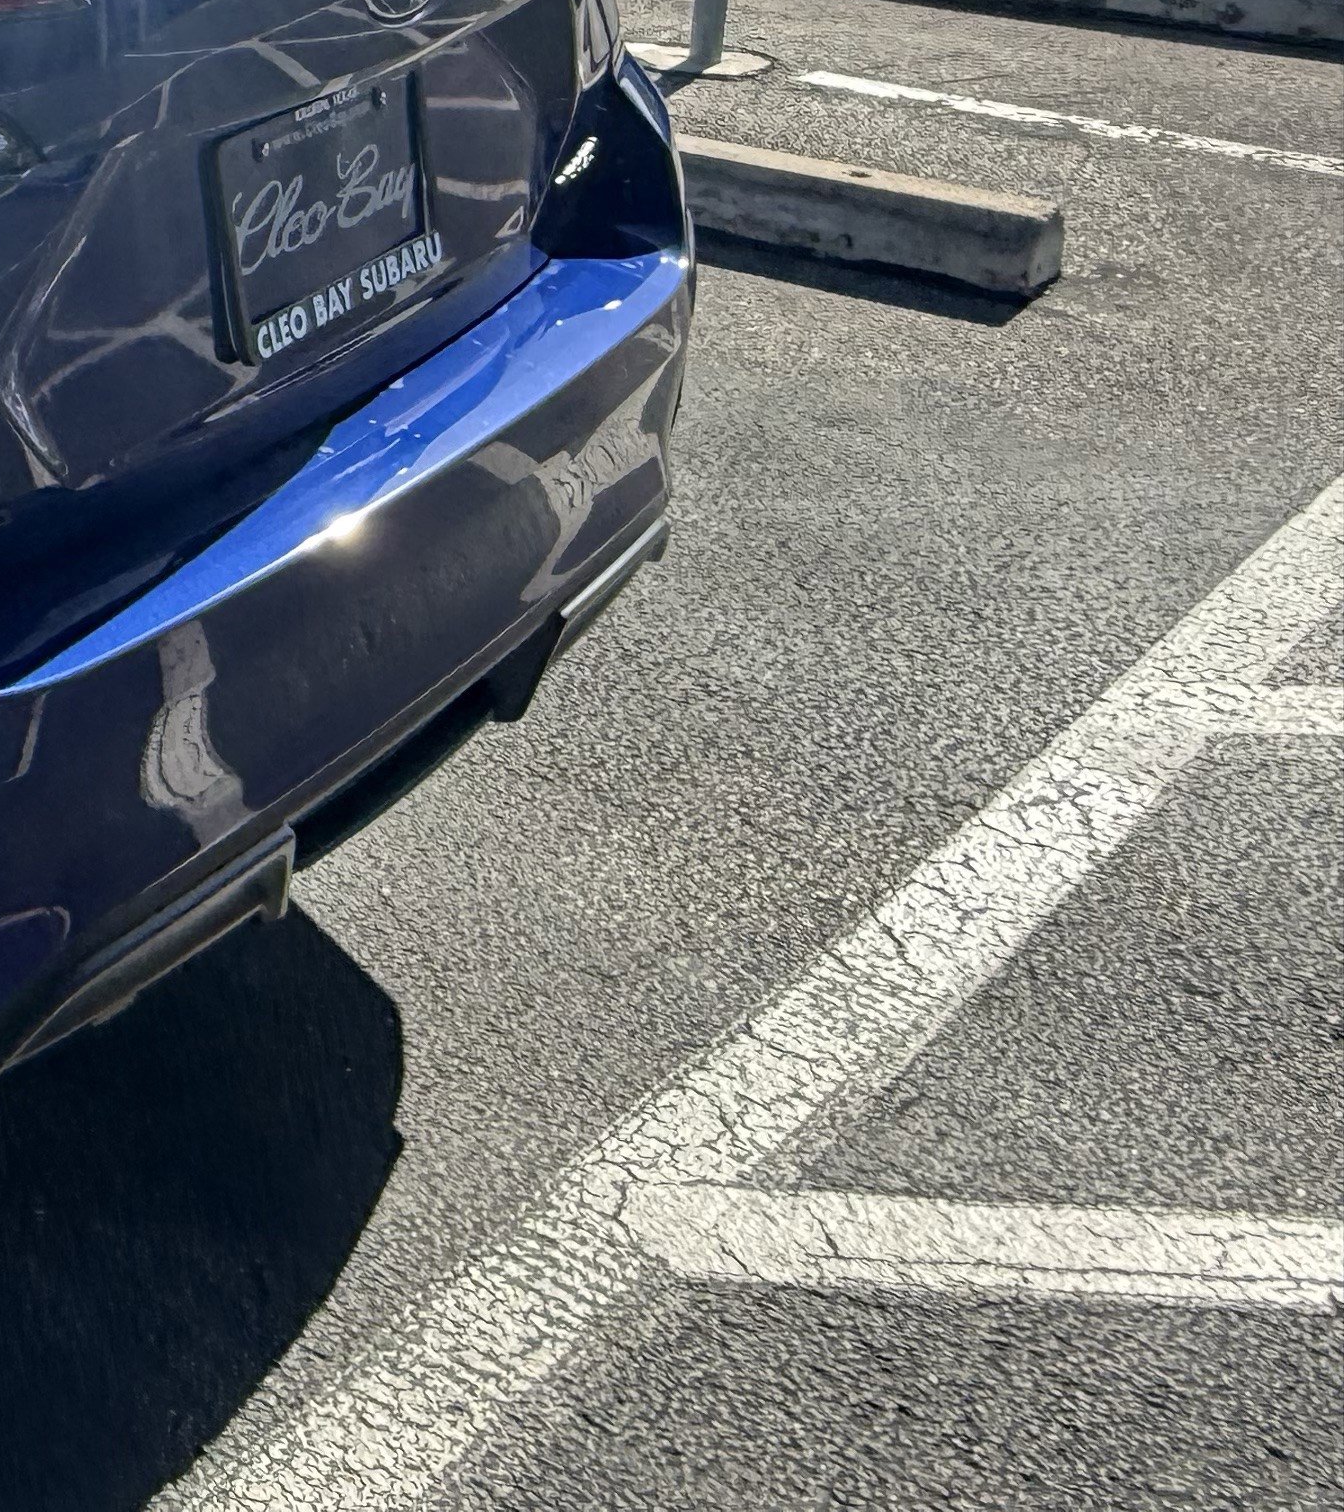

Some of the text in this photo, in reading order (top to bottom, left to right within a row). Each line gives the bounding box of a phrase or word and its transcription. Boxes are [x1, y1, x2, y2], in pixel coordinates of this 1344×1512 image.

[232, 143, 415, 276] Cleo Bay
[257, 232, 443, 359] CLEO BAY SUBARU
